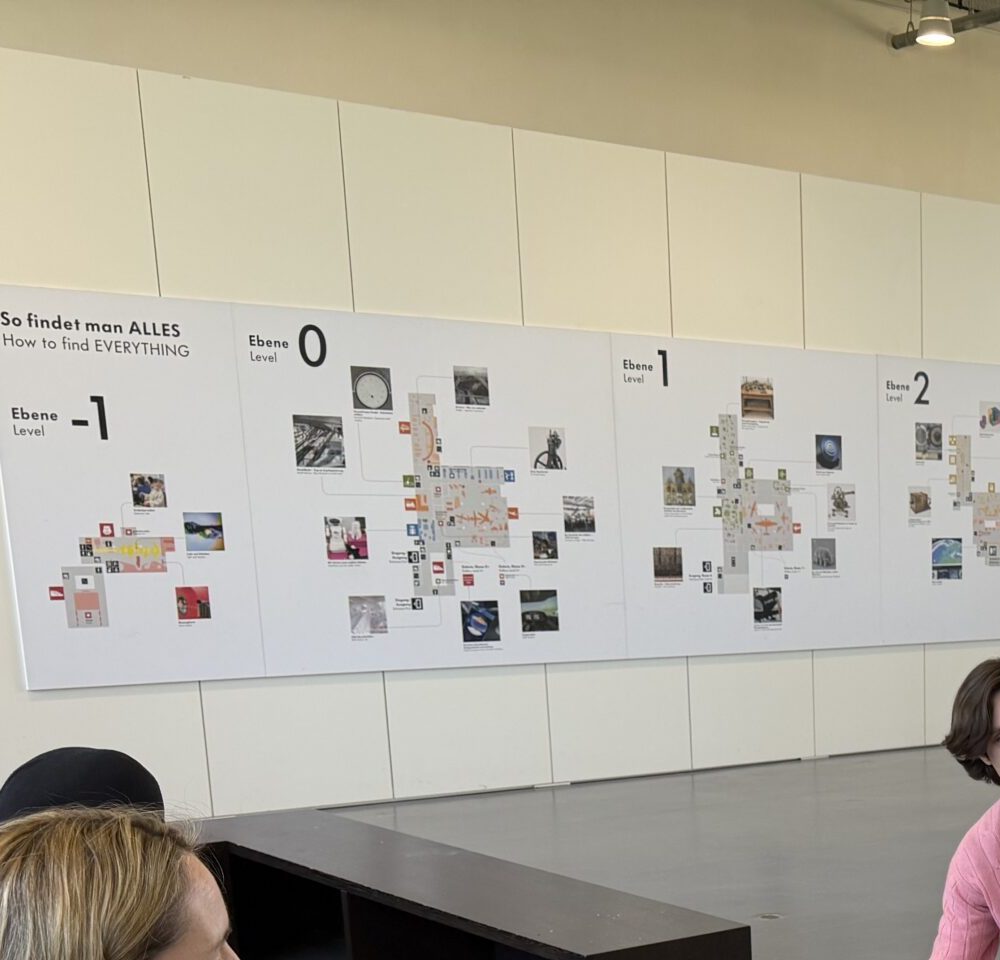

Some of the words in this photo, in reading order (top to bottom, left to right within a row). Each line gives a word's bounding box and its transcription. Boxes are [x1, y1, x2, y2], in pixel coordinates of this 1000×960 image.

[1, 311, 22, 327] So
[27, 313, 80, 331] findet
[85, 321, 123, 334] man
[129, 321, 181, 337] ALLES
[3, 333, 36, 349] How
[42, 337, 56, 349] to
[62, 336, 89, 351] find
[95, 340, 190, 357] EVERYTHING
[248, 335, 289, 348] Ebene
[298, 324, 327, 367] 0
[250, 351, 277, 363] Level
[623, 359, 653, 371] Ebene
[658, 349, 668, 387] 1
[623, 373, 644, 384] Level
[886, 380, 910, 391] Ebene
[914, 371, 930, 405] 2
[886, 393, 903, 402] Level
[11, 407, 58, 421] Ebene
[72, 395, 108, 440] -1
[13, 424, 45, 436] Level
